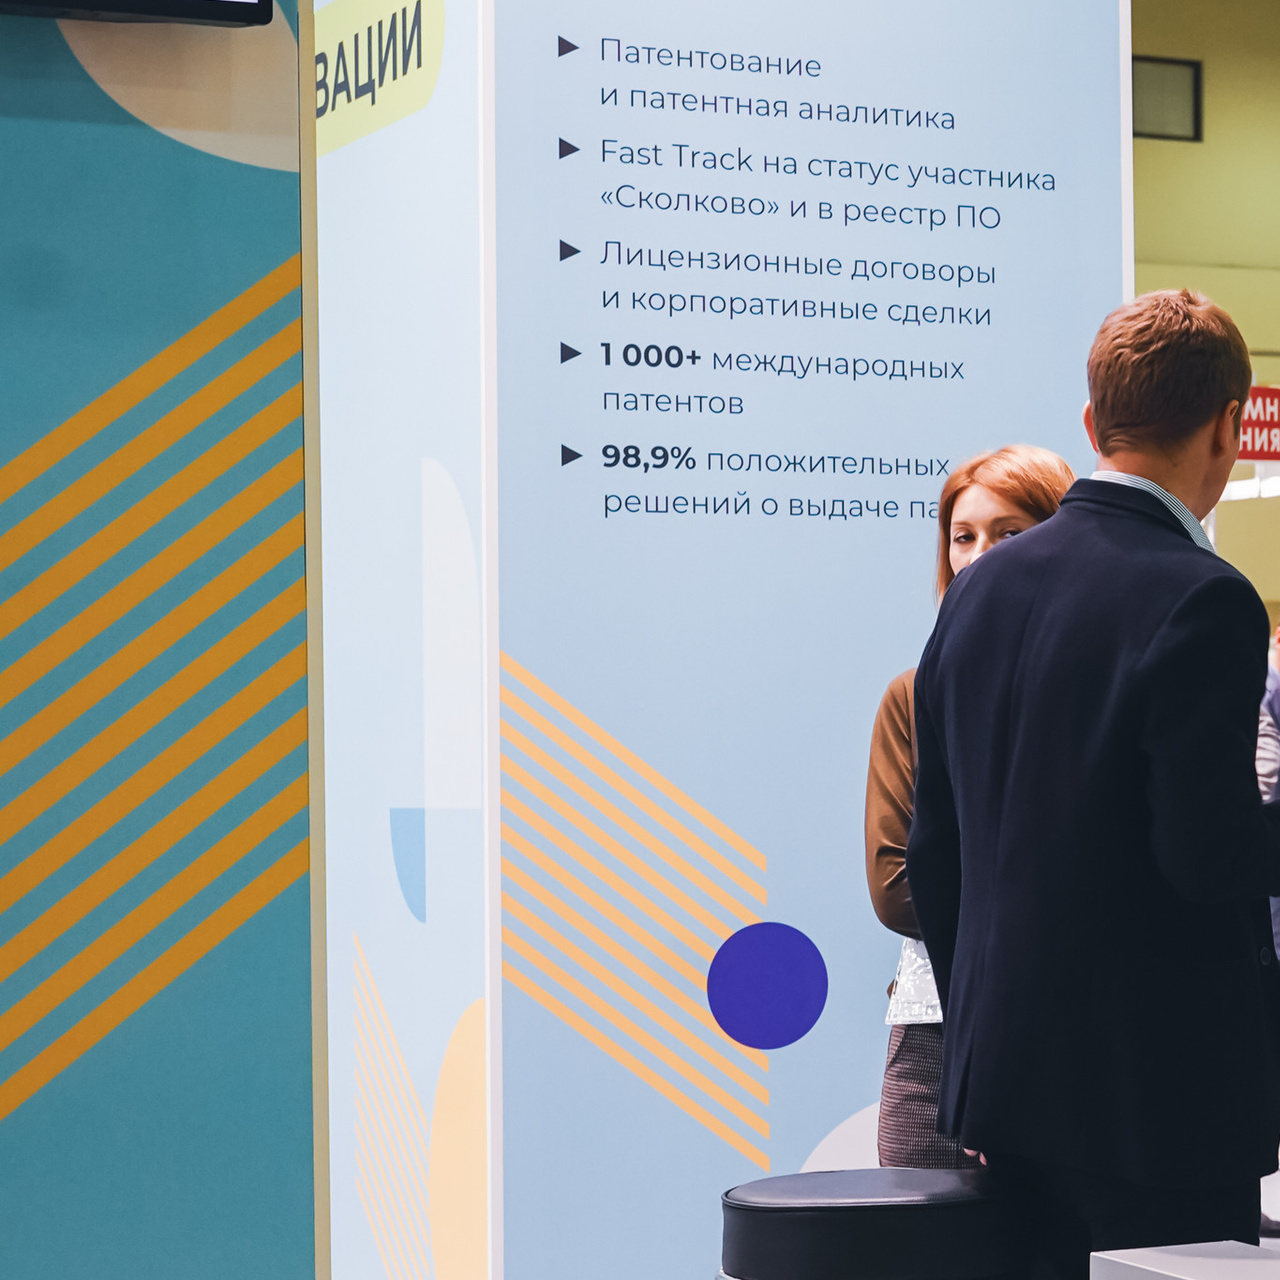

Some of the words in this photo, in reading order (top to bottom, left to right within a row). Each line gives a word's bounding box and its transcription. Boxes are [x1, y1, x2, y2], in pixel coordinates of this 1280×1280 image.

[601, 37, 822, 78] Патентование
[600, 87, 618, 107] и
[630, 89, 788, 119] патентная
[798, 101, 956, 130] аналитика
[601, 138, 664, 167] Fast
[671, 143, 754, 173] Track
[763, 155, 798, 175] на
[807, 158, 900, 186] статус
[906, 164, 1056, 191] участника
[600, 184, 780, 216] «Сколково»
[790, 199, 807, 219] и
[818, 201, 834, 220] в
[844, 203, 947, 232] реестр
[957, 204, 1001, 230] ПО
[599, 240, 843, 277] Лицензионные
[850, 259, 996, 289] договоры
[602, 290, 620, 309] и
[632, 291, 878, 321] корпоративные
[887, 303, 991, 327] сделки
[713, 352, 965, 382] международных
[603, 392, 744, 415] патентов
[601, 444, 697, 474] 98,9%
[707, 452, 950, 477] положительных
[604, 490, 751, 519] решений
[761, 497, 779, 516] о
[789, 498, 900, 521] выдаче
